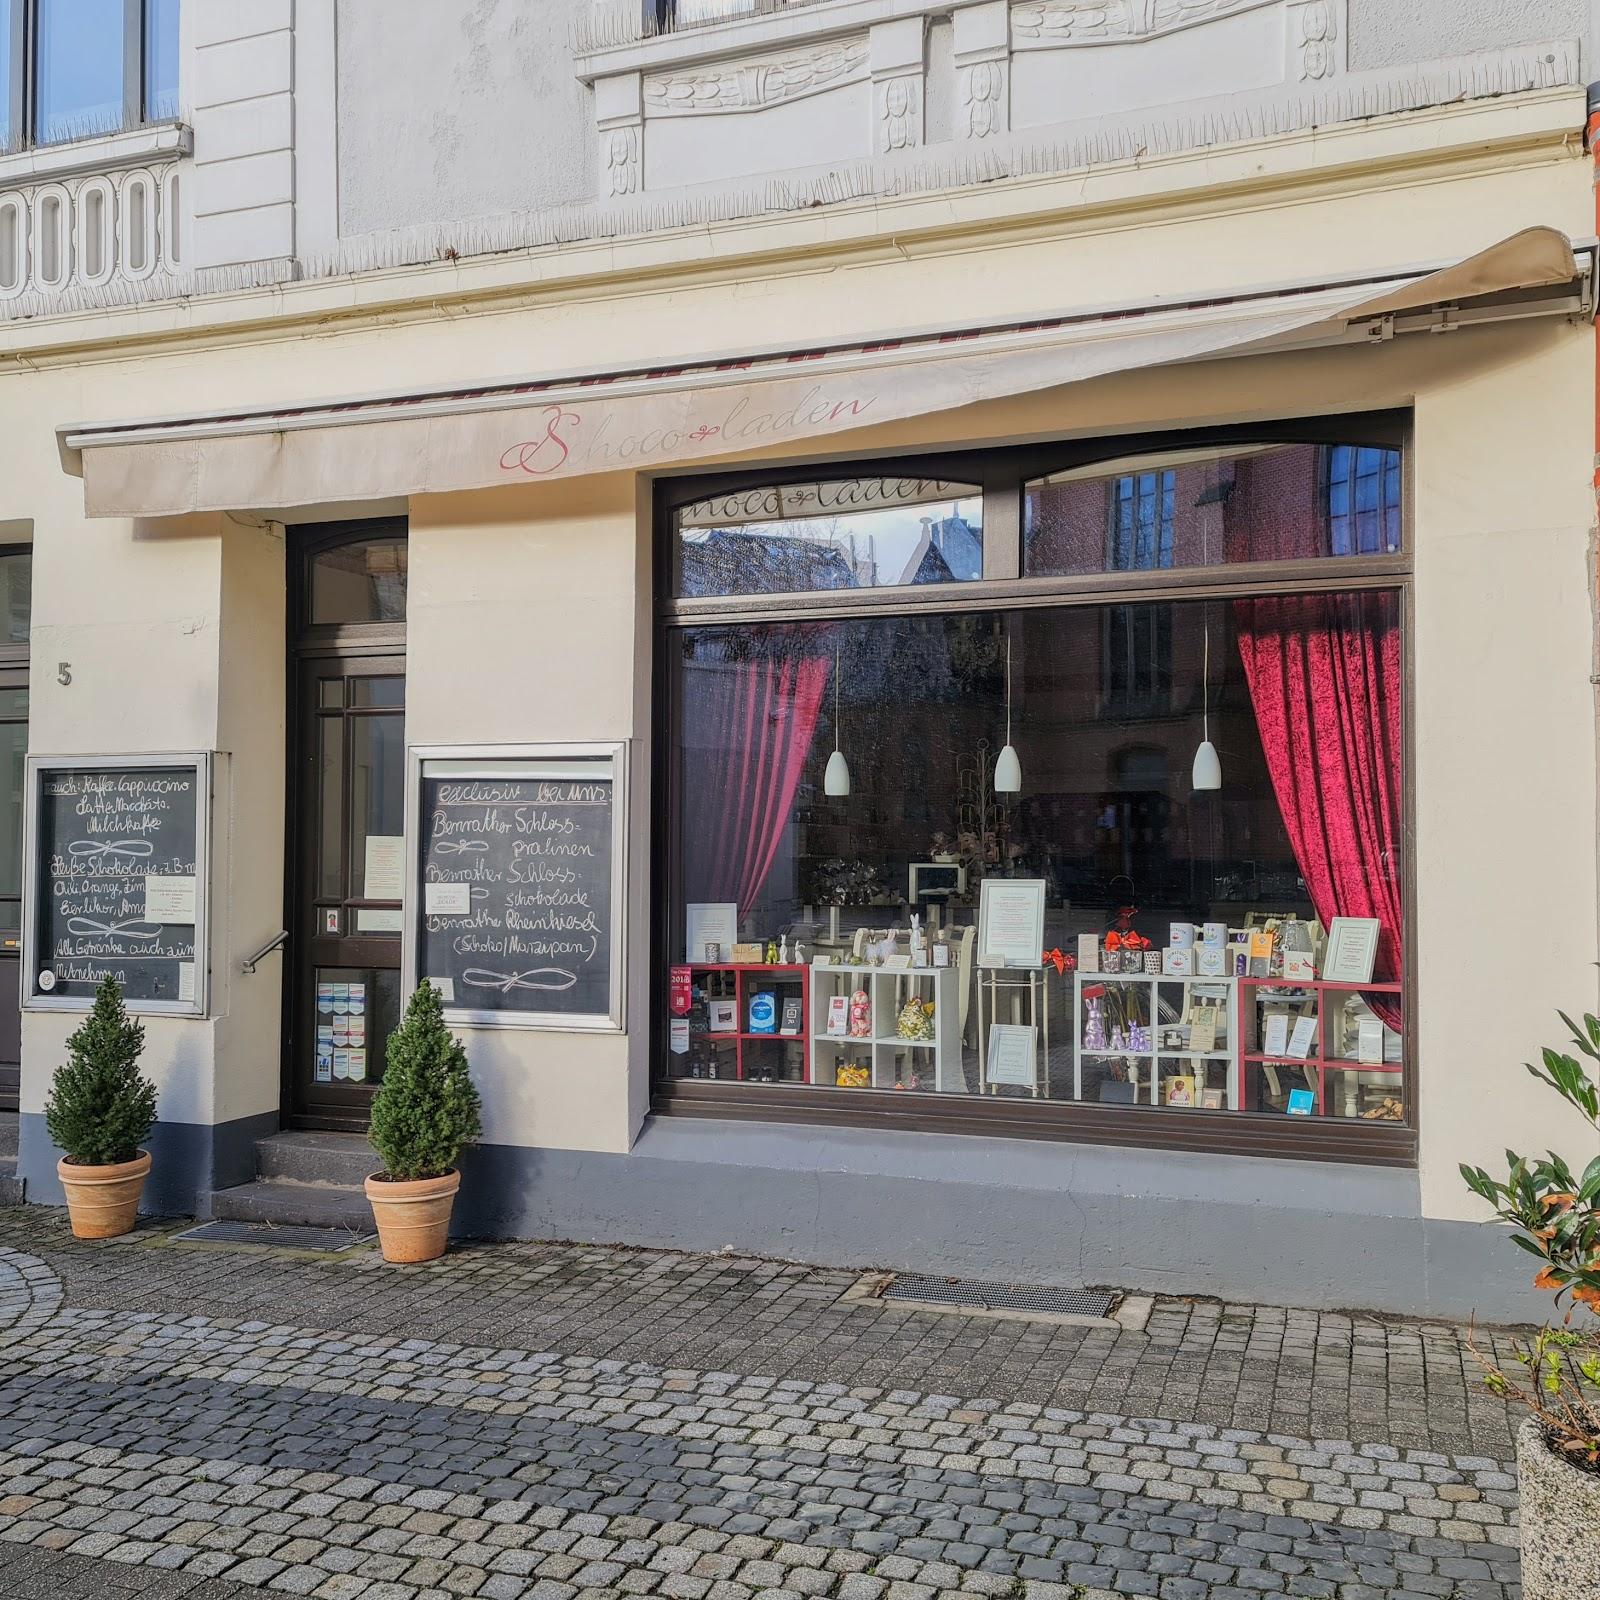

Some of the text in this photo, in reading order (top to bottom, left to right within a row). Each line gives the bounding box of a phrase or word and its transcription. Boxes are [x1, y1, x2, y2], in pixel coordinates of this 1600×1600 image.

[57, 662, 72, 686] 5
[51, 776, 80, 793] auch:
[130, 937, 164, 955] auch
